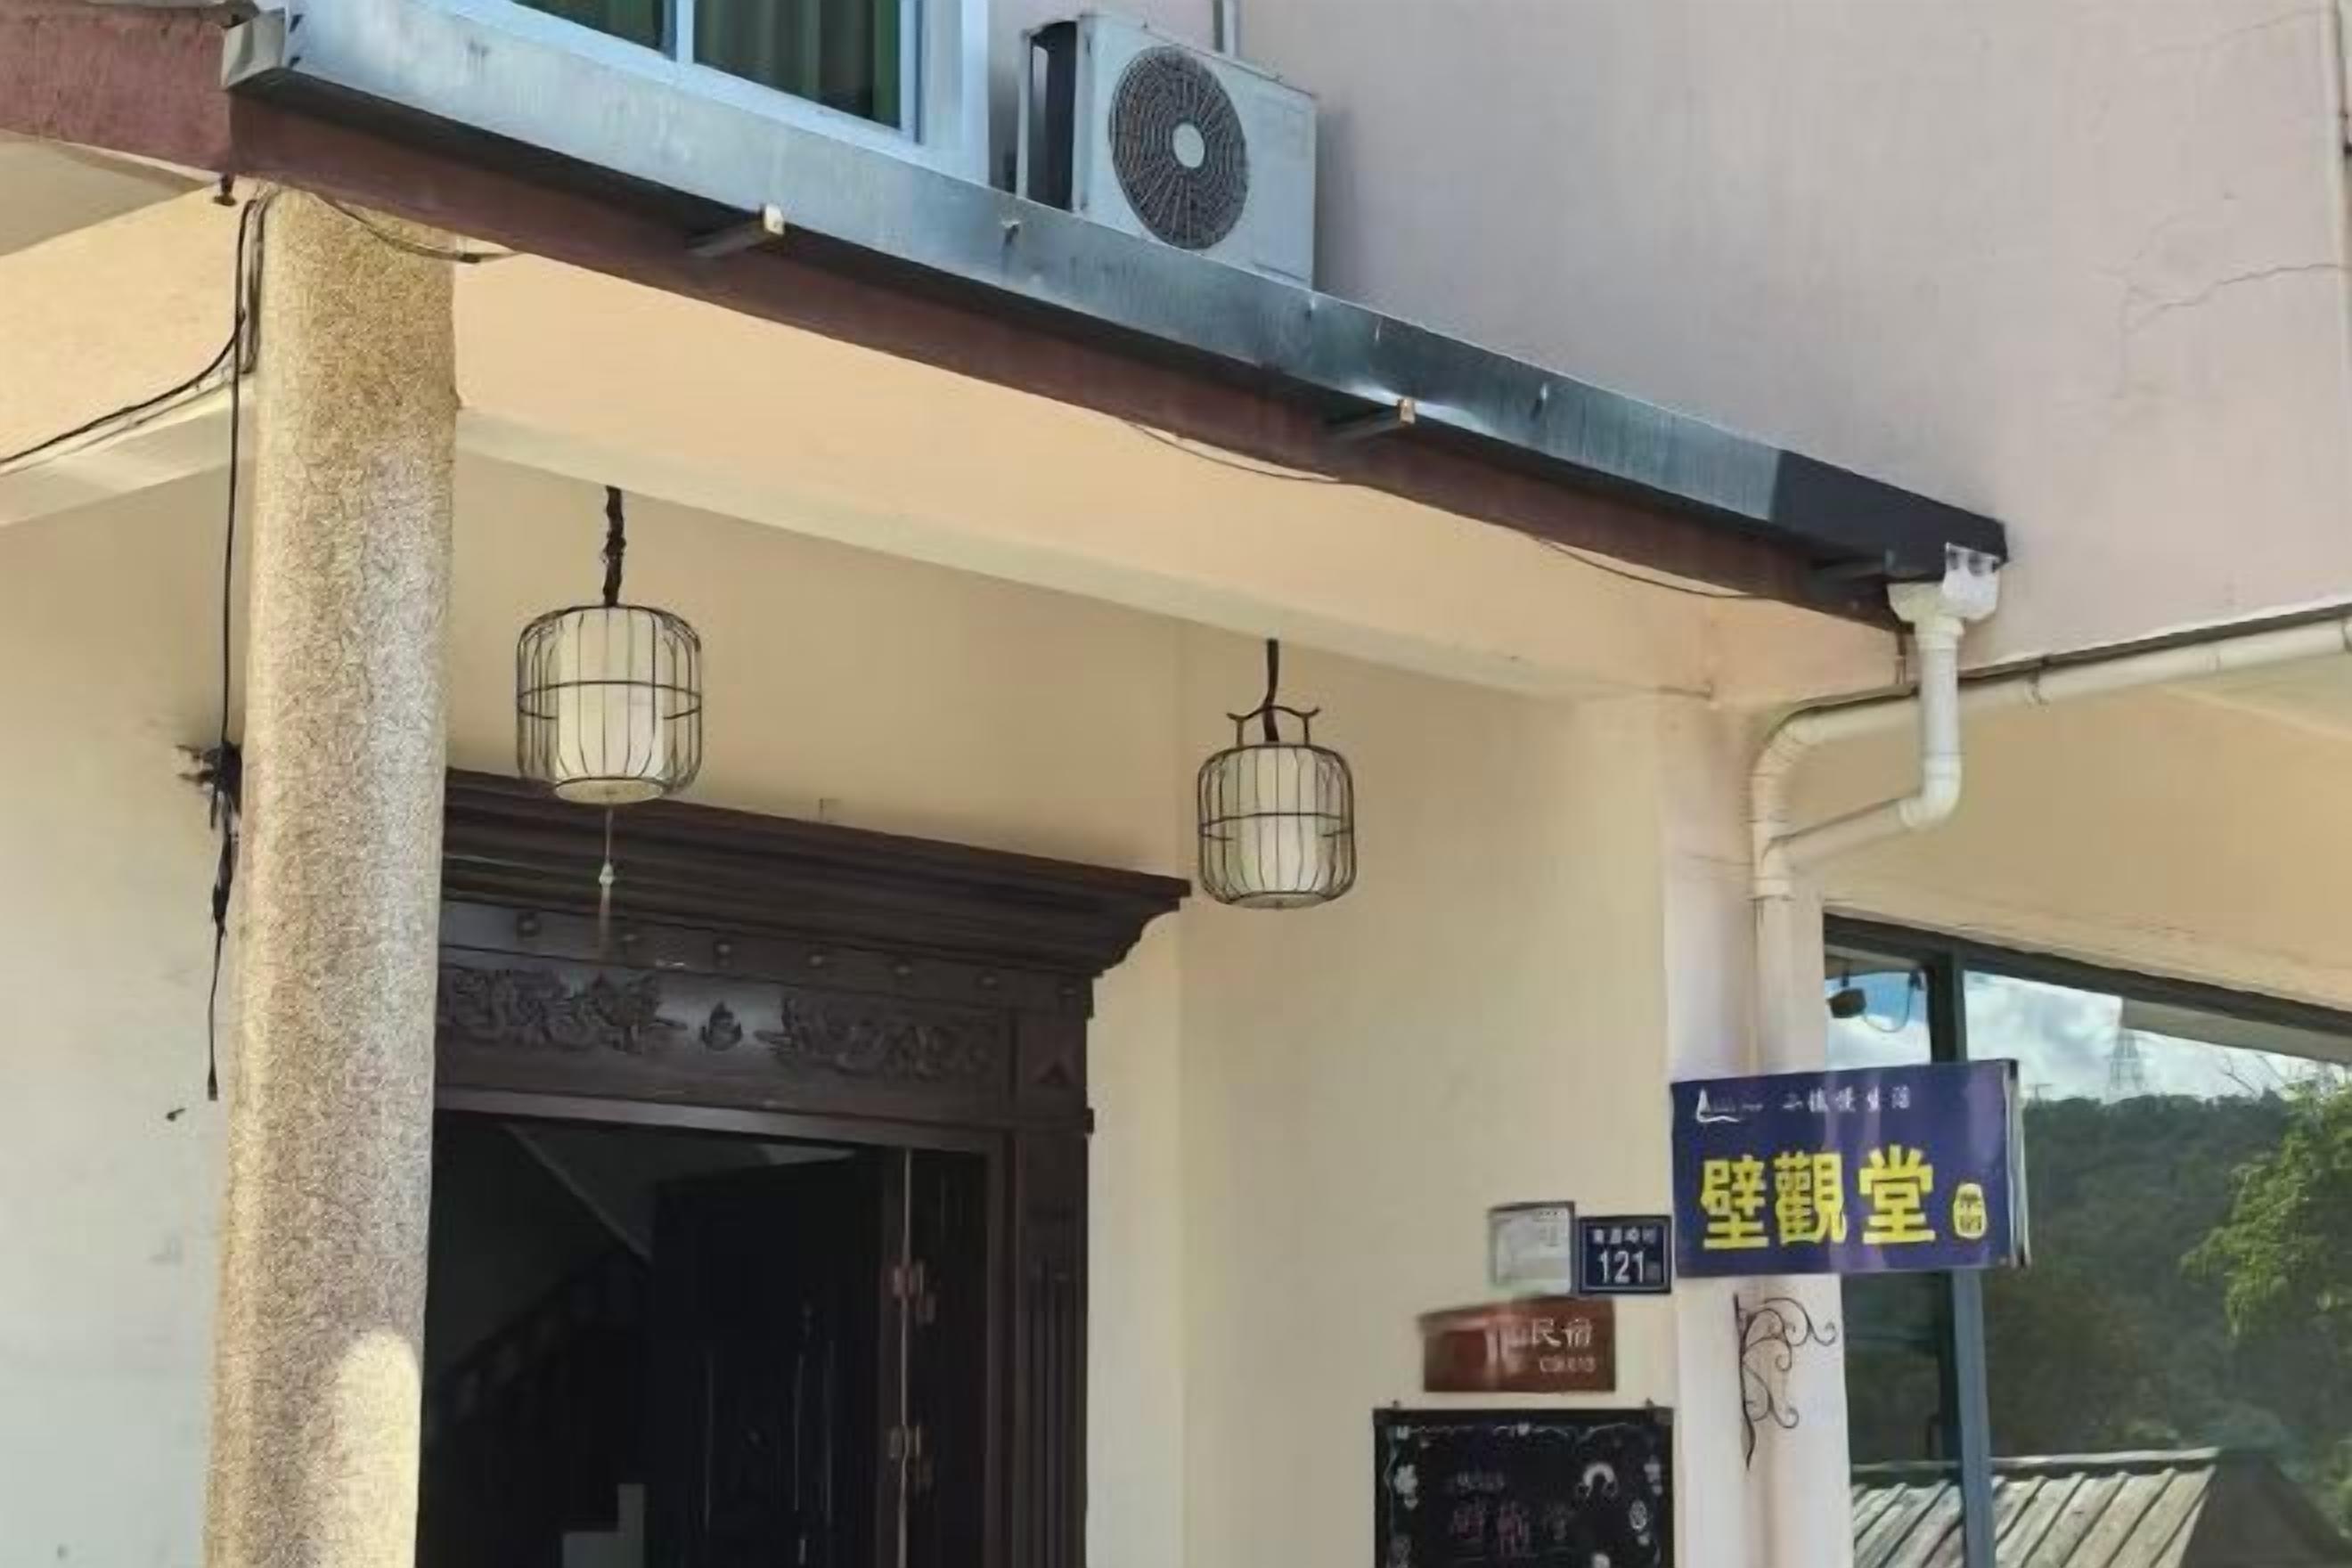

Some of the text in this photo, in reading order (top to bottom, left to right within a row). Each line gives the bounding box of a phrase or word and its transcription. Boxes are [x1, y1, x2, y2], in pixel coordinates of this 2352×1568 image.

[1701, 1145, 1936, 1249] 壁觀堂
[1598, 1250, 1645, 1284] 121
